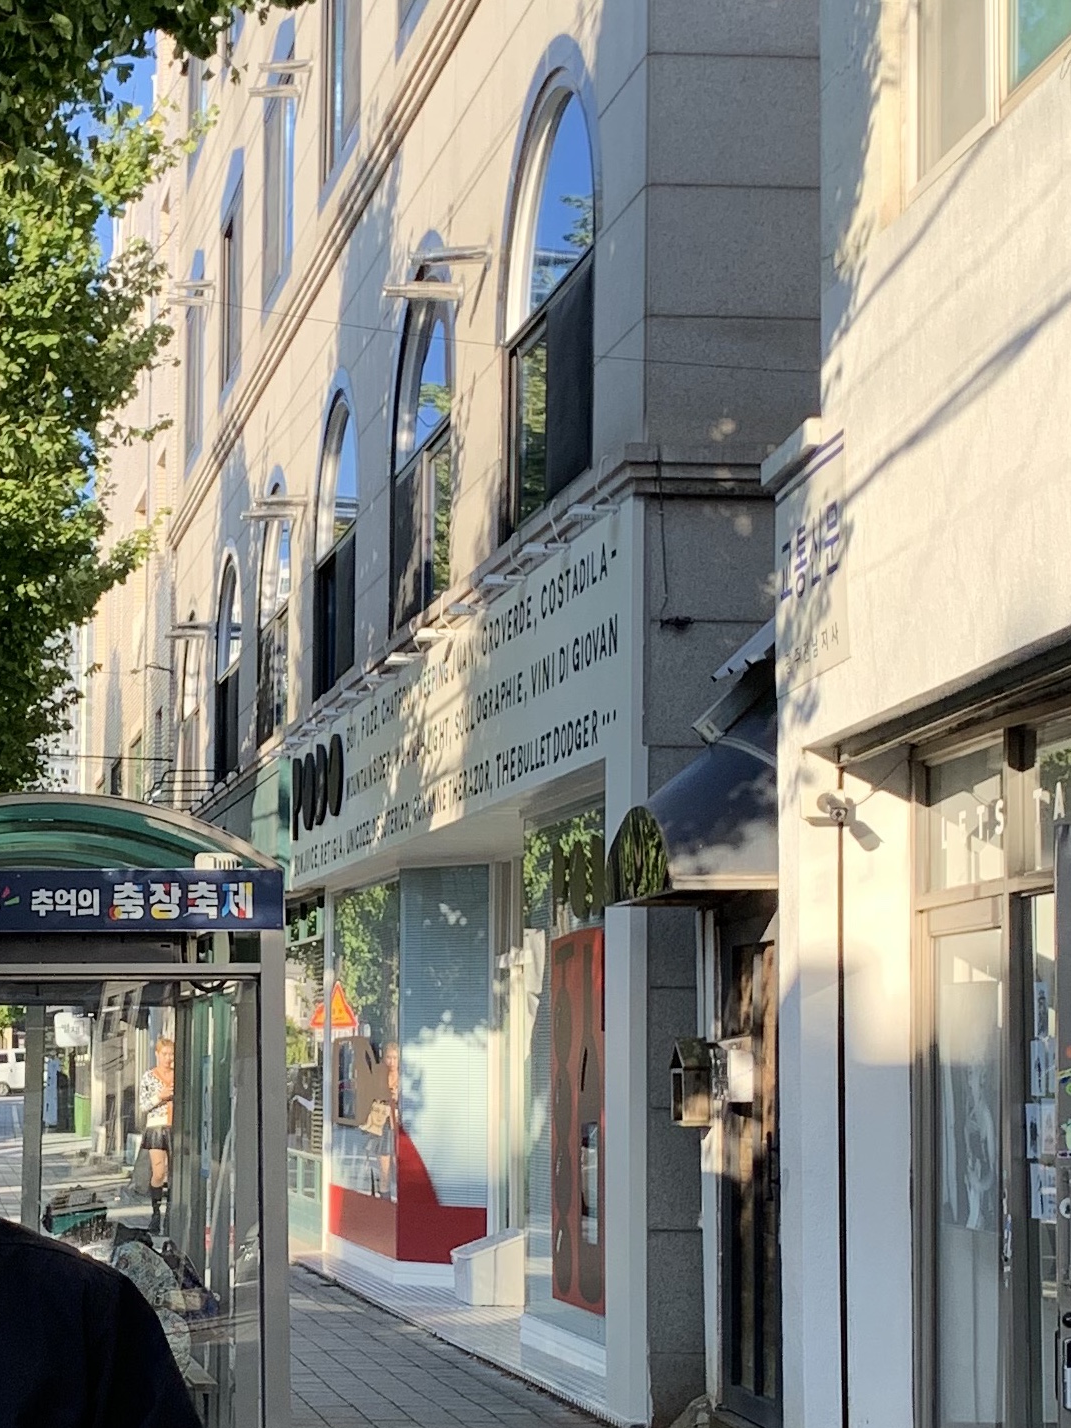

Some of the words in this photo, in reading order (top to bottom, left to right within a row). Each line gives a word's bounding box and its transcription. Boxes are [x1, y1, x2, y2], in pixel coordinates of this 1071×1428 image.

[780, 499, 840, 601] 교통신문
[482, 596, 537, 656] OROVERDE,
[530, 652, 555, 697] VINI
[559, 643, 569, 683] DI
[572, 613, 618, 672] GIOVAN
[292, 733, 344, 841] PODO
[31, 888, 100, 917] 추억의
[113, 881, 253, 921] 충장축제
